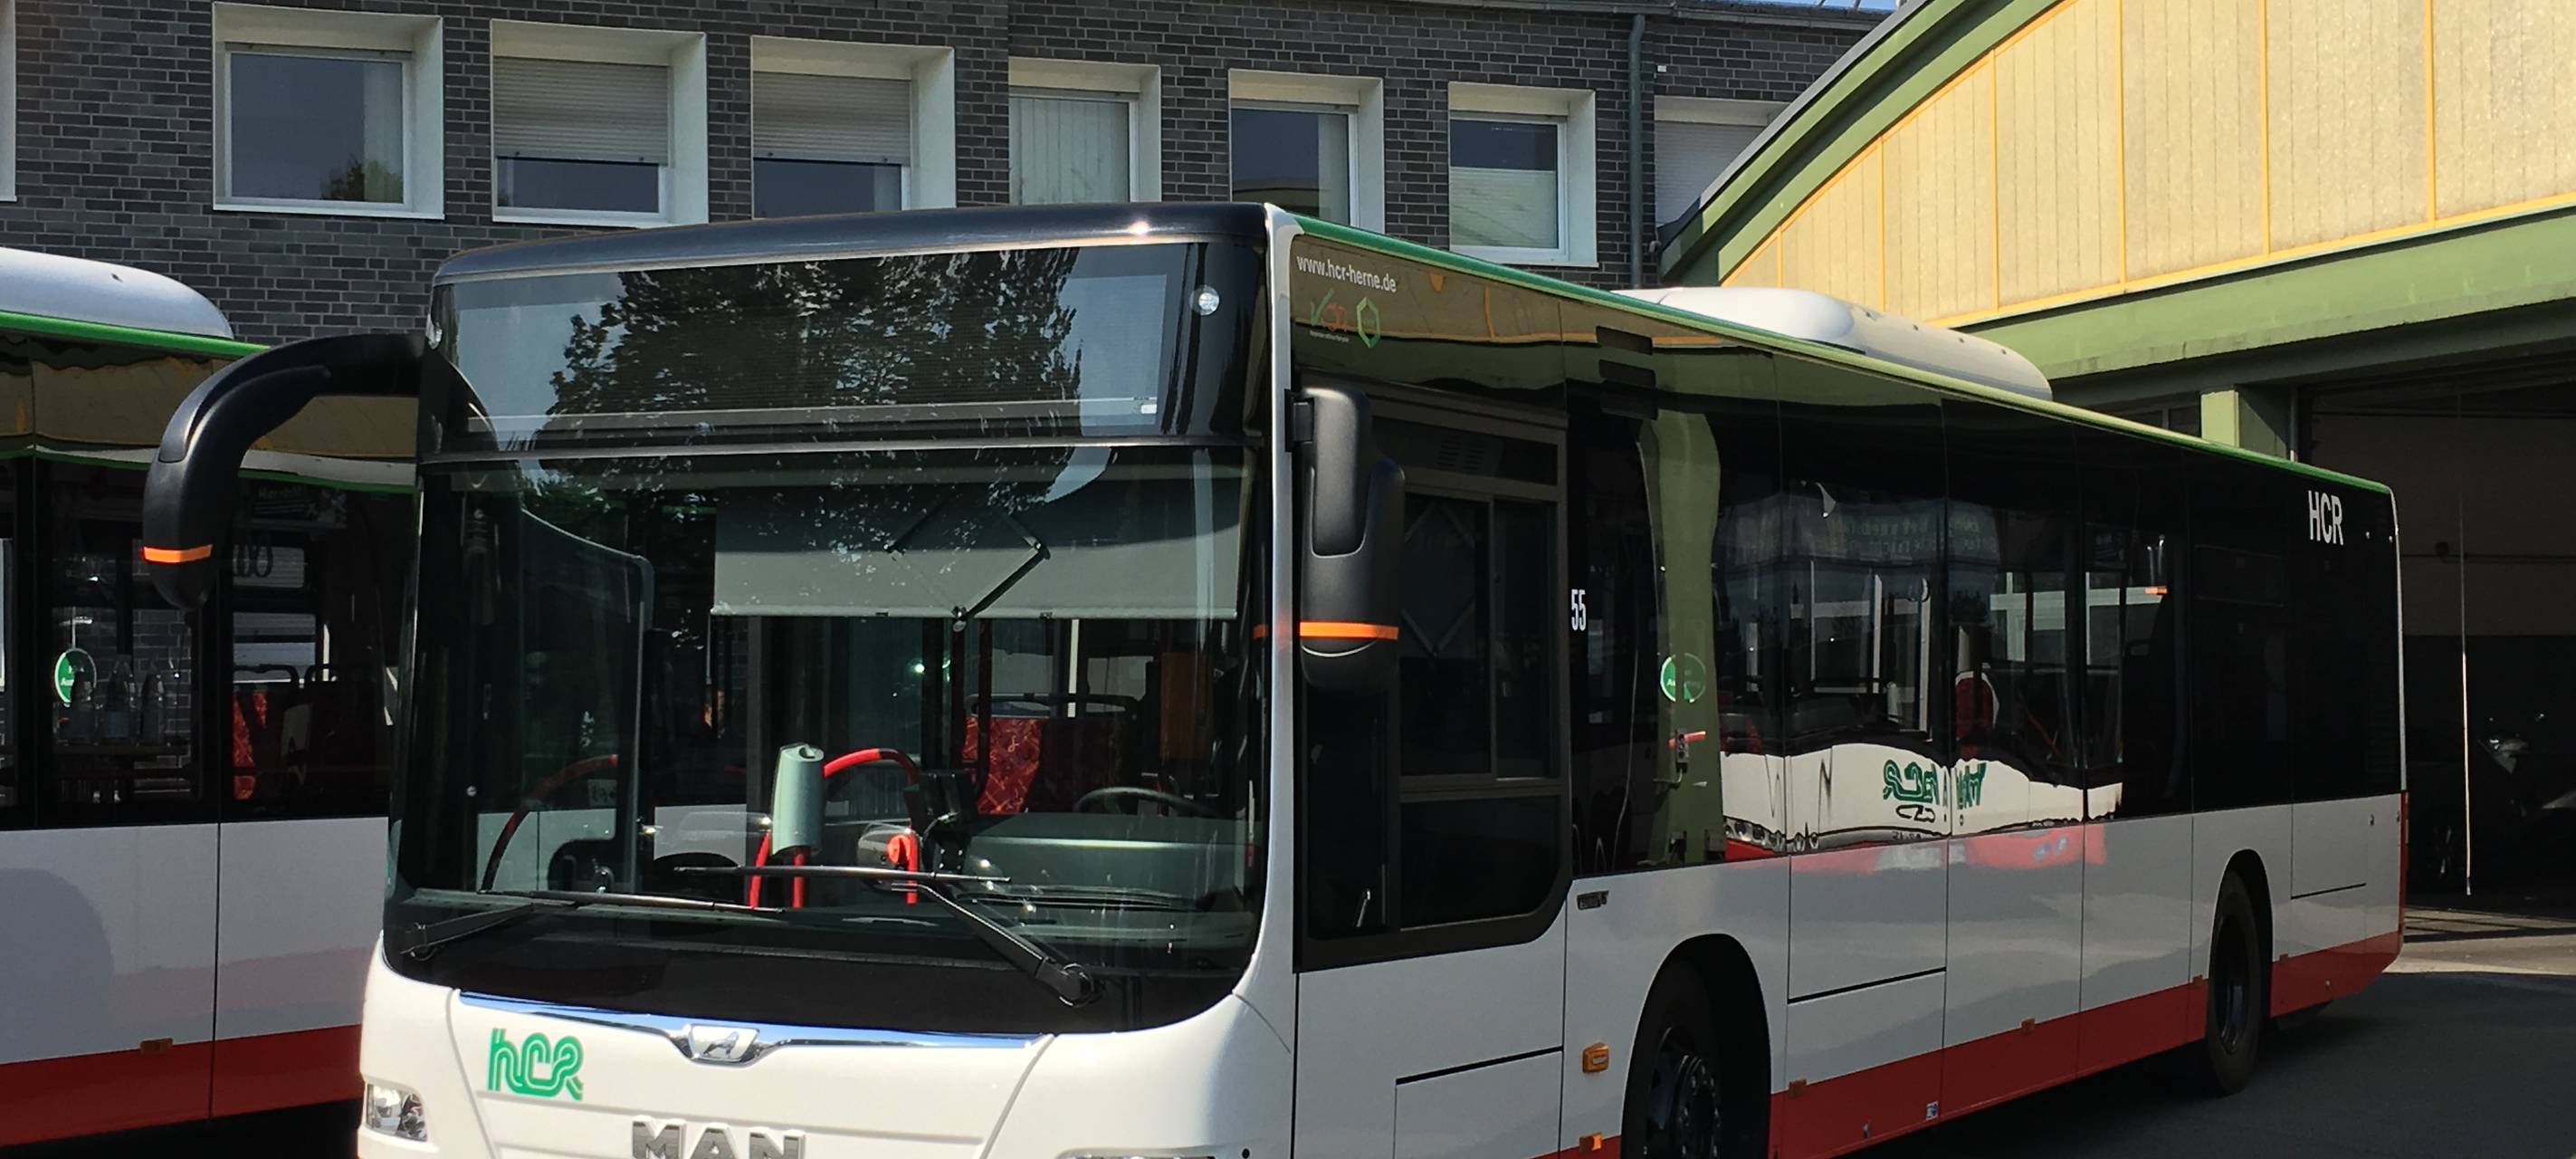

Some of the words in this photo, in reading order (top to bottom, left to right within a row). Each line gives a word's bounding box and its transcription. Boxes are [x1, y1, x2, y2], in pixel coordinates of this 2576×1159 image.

[1297, 256, 1397, 292] www.hcr-herne.de
[2308, 490, 2343, 545] HCR
[1571, 589, 1586, 631] 55
[633, 1116, 806, 1159] MAN
